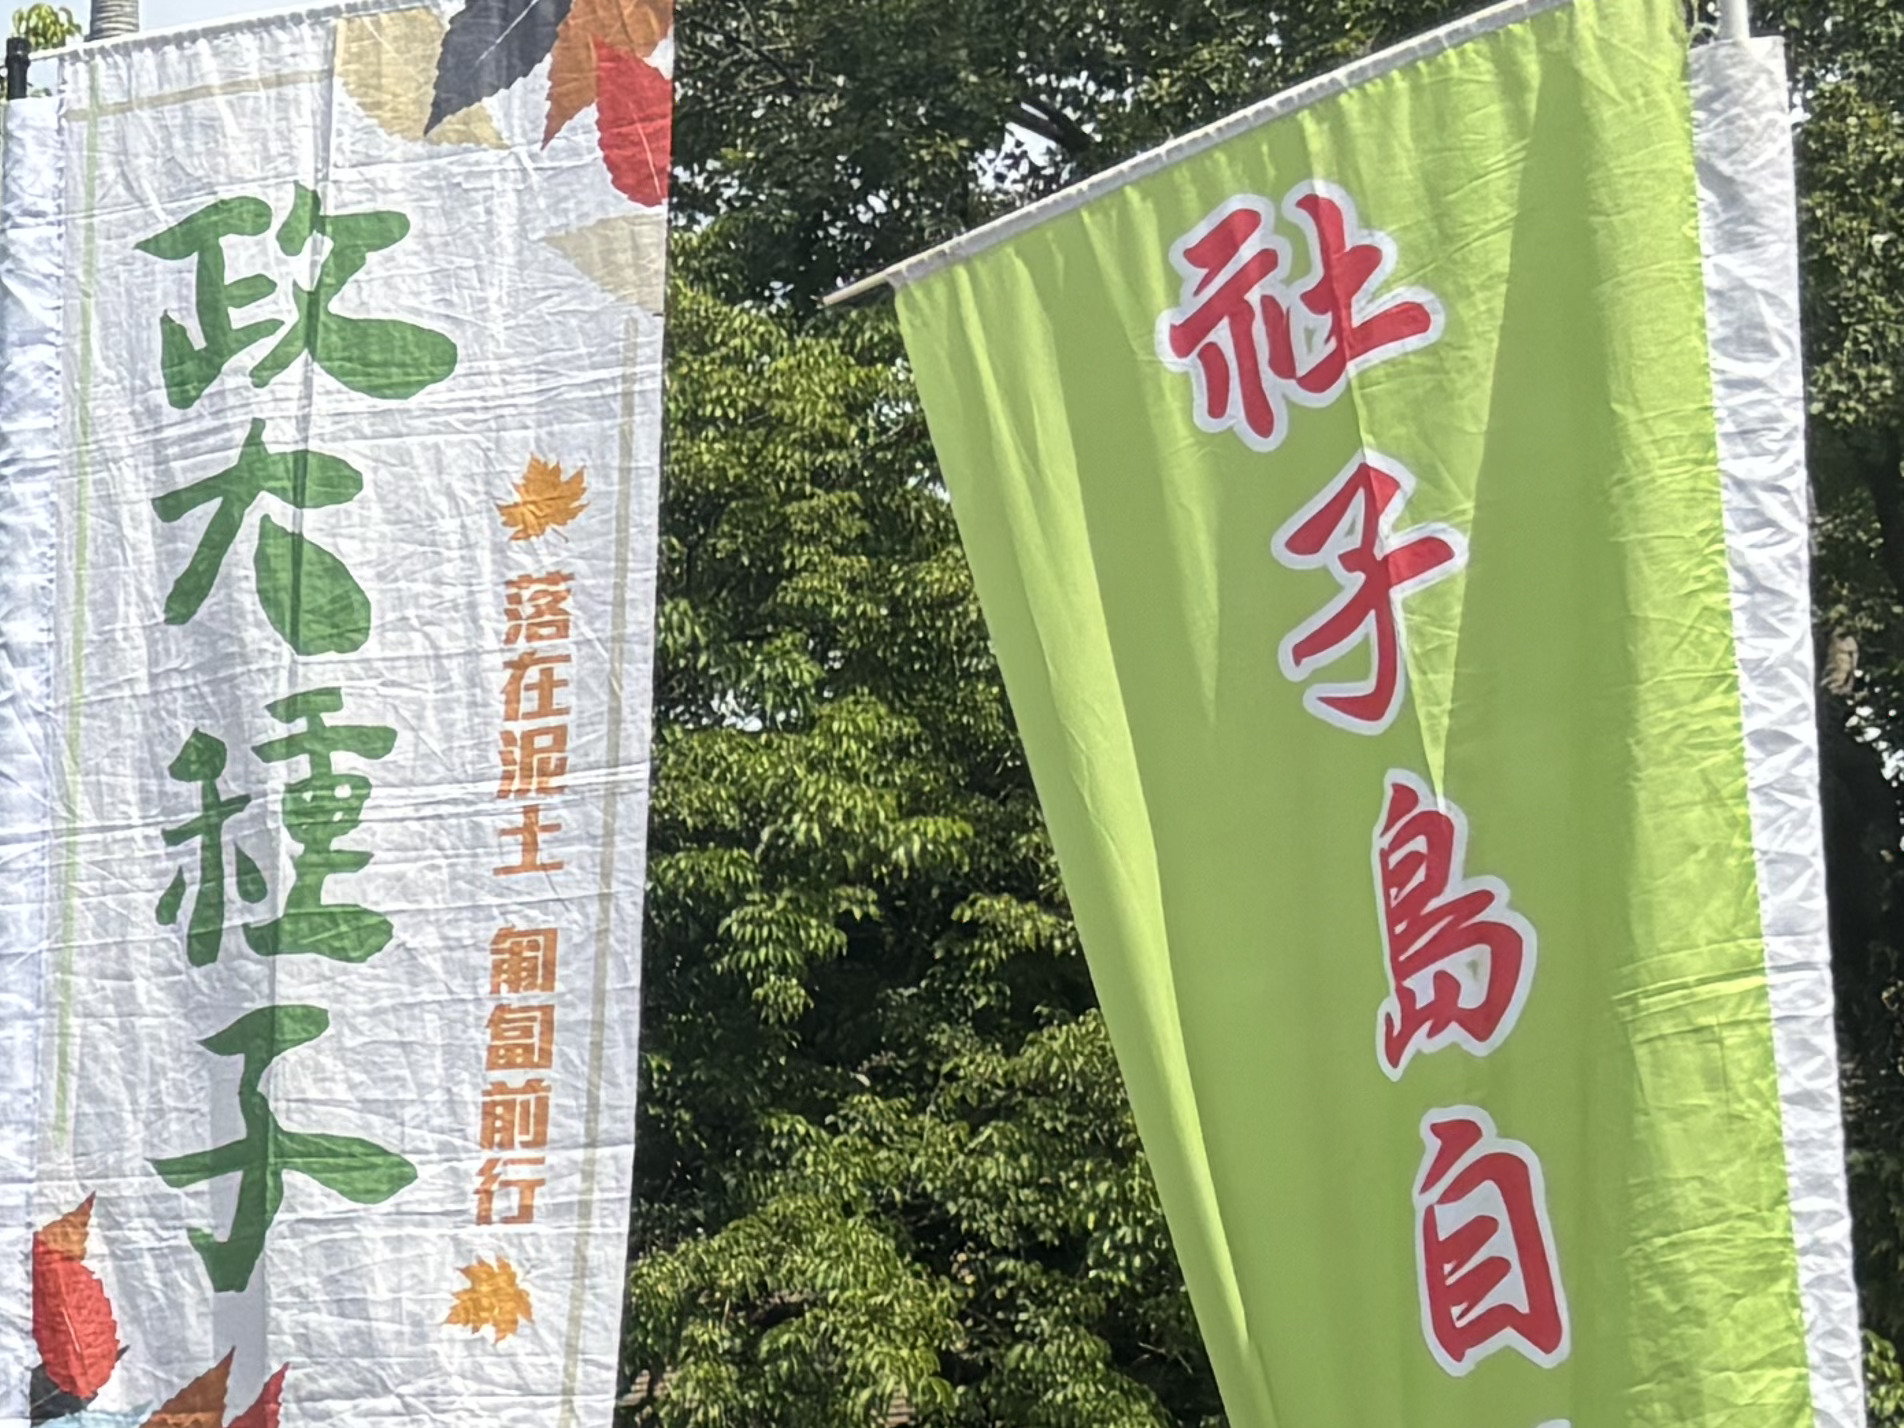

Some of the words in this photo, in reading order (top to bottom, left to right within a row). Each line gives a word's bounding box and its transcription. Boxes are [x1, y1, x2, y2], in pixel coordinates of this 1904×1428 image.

[133, 183, 457, 1292] 政大種子
[493, 572, 575, 876] 落在泥土
[474, 927, 559, 1225] 匍匐前行
